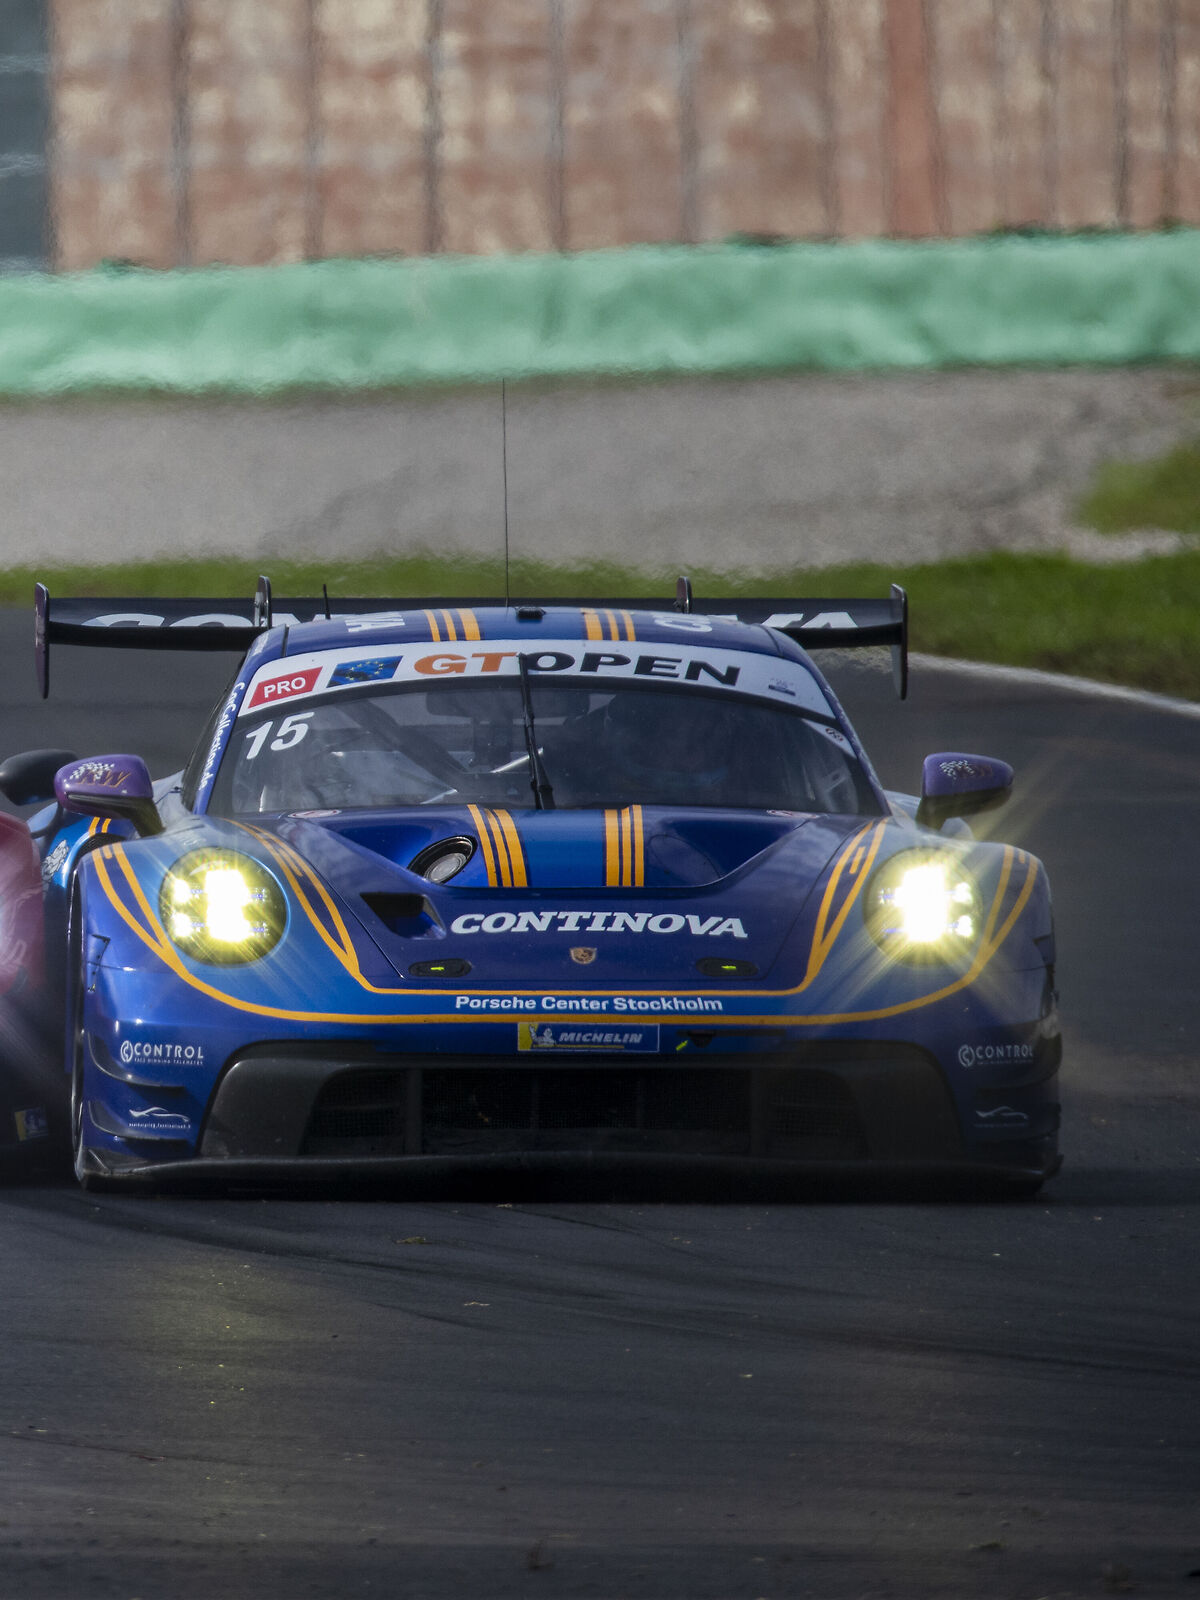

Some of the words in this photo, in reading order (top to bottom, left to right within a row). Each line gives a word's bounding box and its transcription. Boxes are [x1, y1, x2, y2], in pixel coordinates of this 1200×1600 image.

[263, 677, 306, 698] PRO
[246, 712, 315, 760] 15
[450, 911, 748, 938] CONTINOVA
[456, 996, 536, 1010] Porsche
[541, 997, 608, 1010] Center
[613, 997, 723, 1011] Stockholm
[559, 1032, 643, 1044] MICHELIN
[134, 1042, 204, 1059] CONTROL
[976, 1045, 1033, 1059] CONTROL
